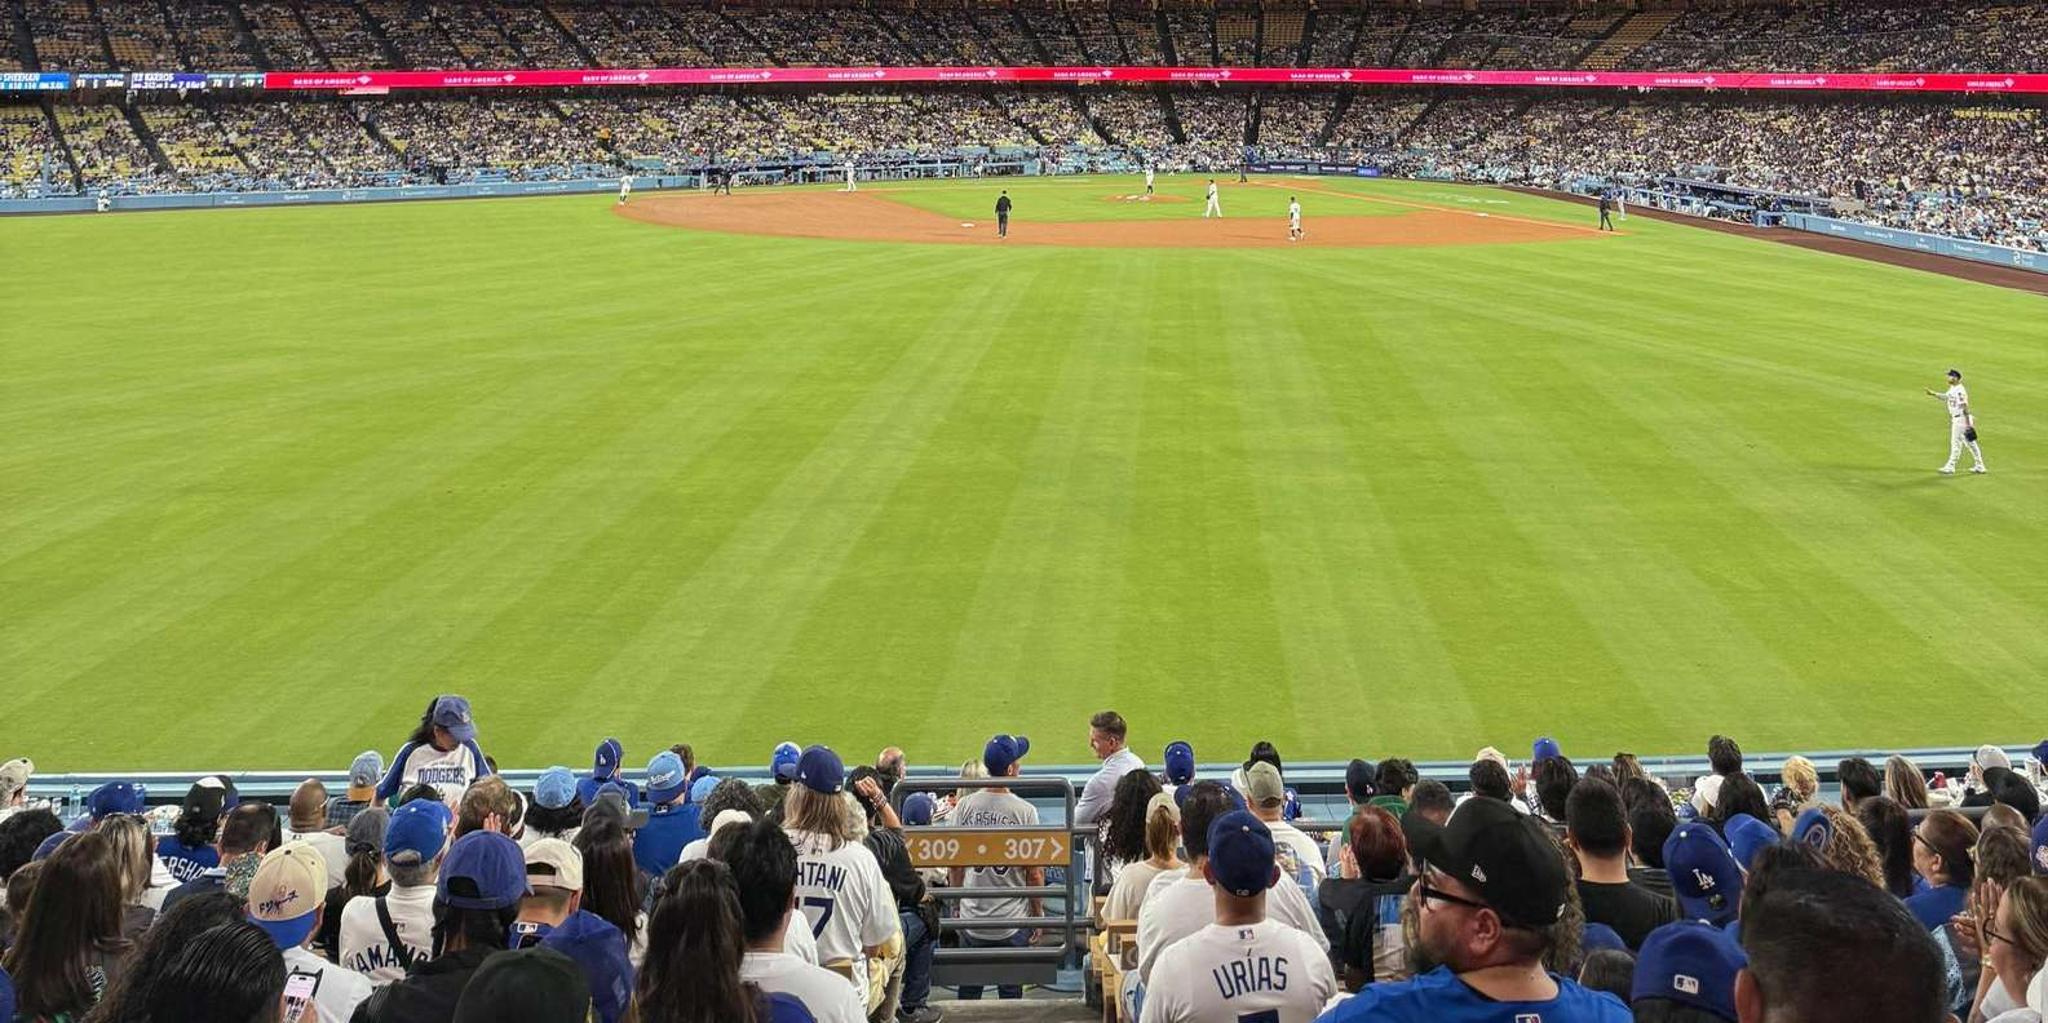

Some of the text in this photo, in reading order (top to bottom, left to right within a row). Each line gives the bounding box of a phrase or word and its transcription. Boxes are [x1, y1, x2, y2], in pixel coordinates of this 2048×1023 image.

[418, 766, 466, 786] DODGERS
[918, 838, 1046, 861] 309 307
[1212, 948, 1289, 1000] URÍAS
